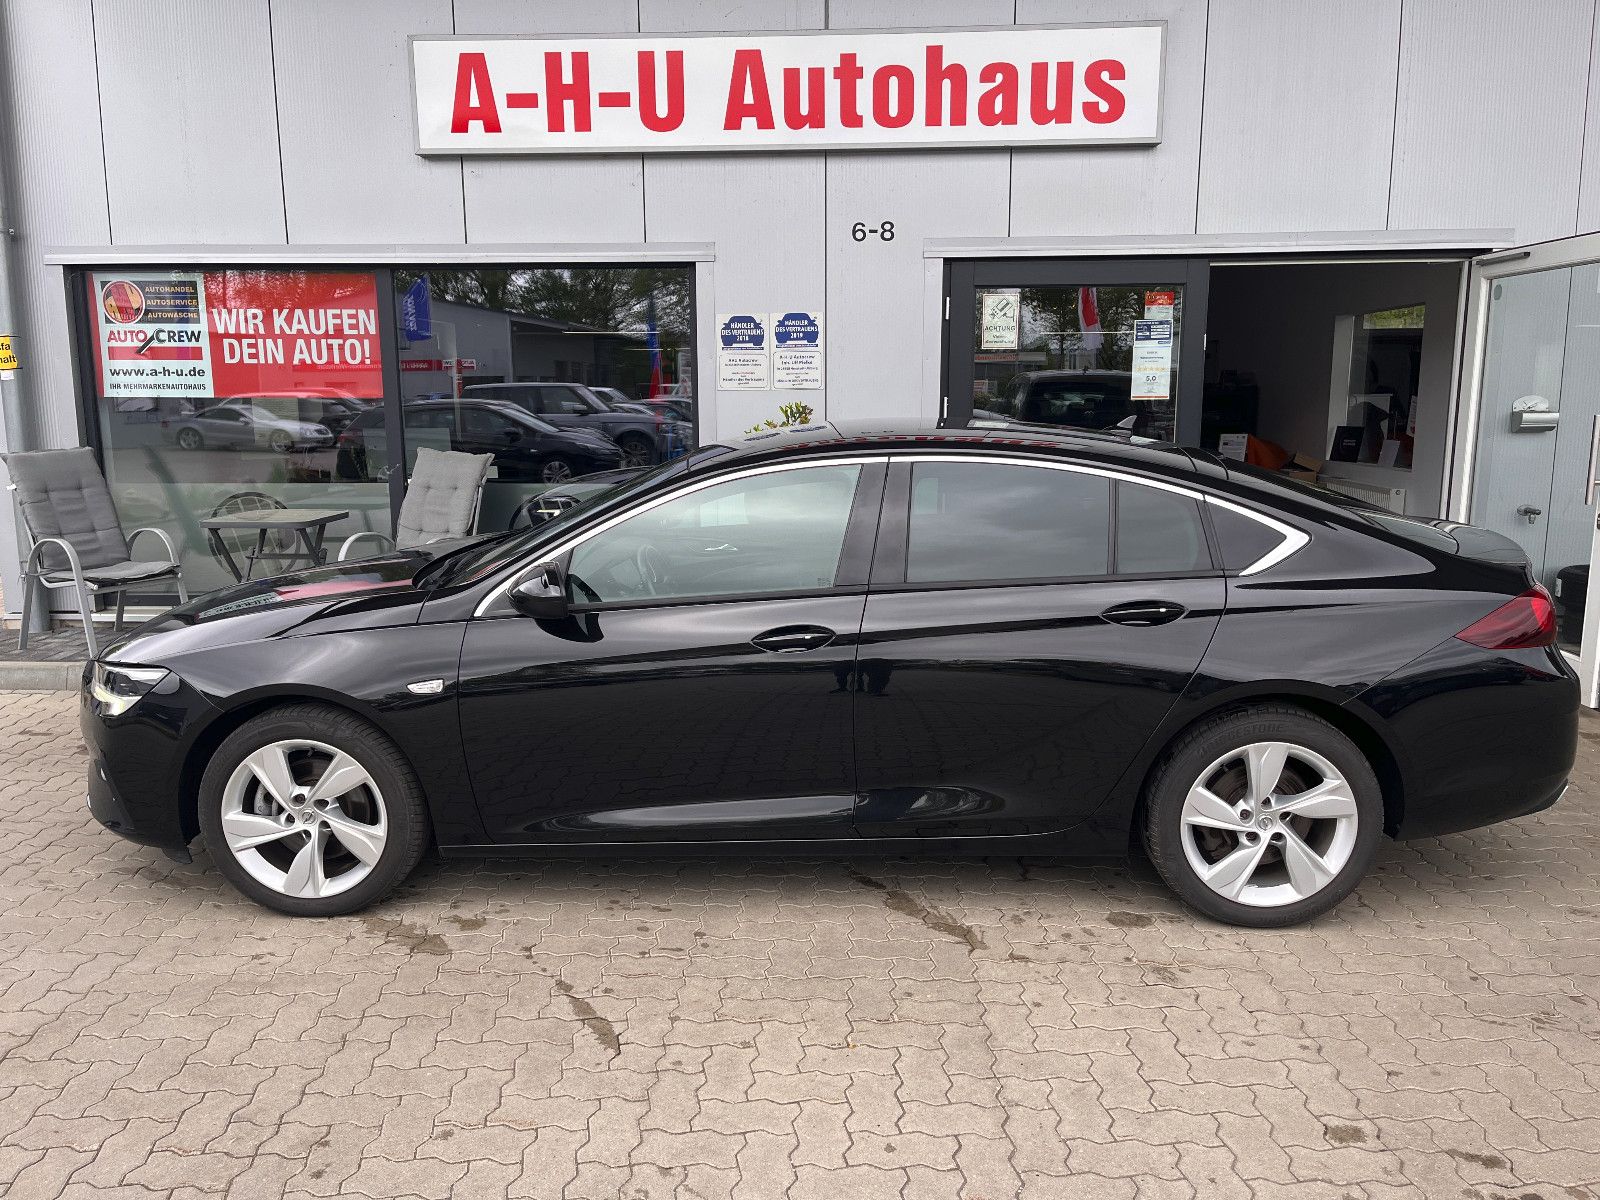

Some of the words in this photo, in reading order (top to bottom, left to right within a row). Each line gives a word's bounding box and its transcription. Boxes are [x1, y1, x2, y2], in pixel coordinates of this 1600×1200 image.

[449, 50, 685, 134] A-H-U
[722, 44, 1127, 132] Autohaus
[850, 221, 896, 243] 6-8
[212, 308, 266, 335] WIR
[272, 308, 377, 335] KAUFEN
[107, 330, 148, 343] AUTO
[154, 329, 202, 344] CREW
[222, 338, 285, 364] DEIN
[292, 338, 371, 365] AUTO!
[109, 367, 206, 377] www.a-h-u.de
[124, 383, 207, 391] MEHRMARKENAUTOHAUS
